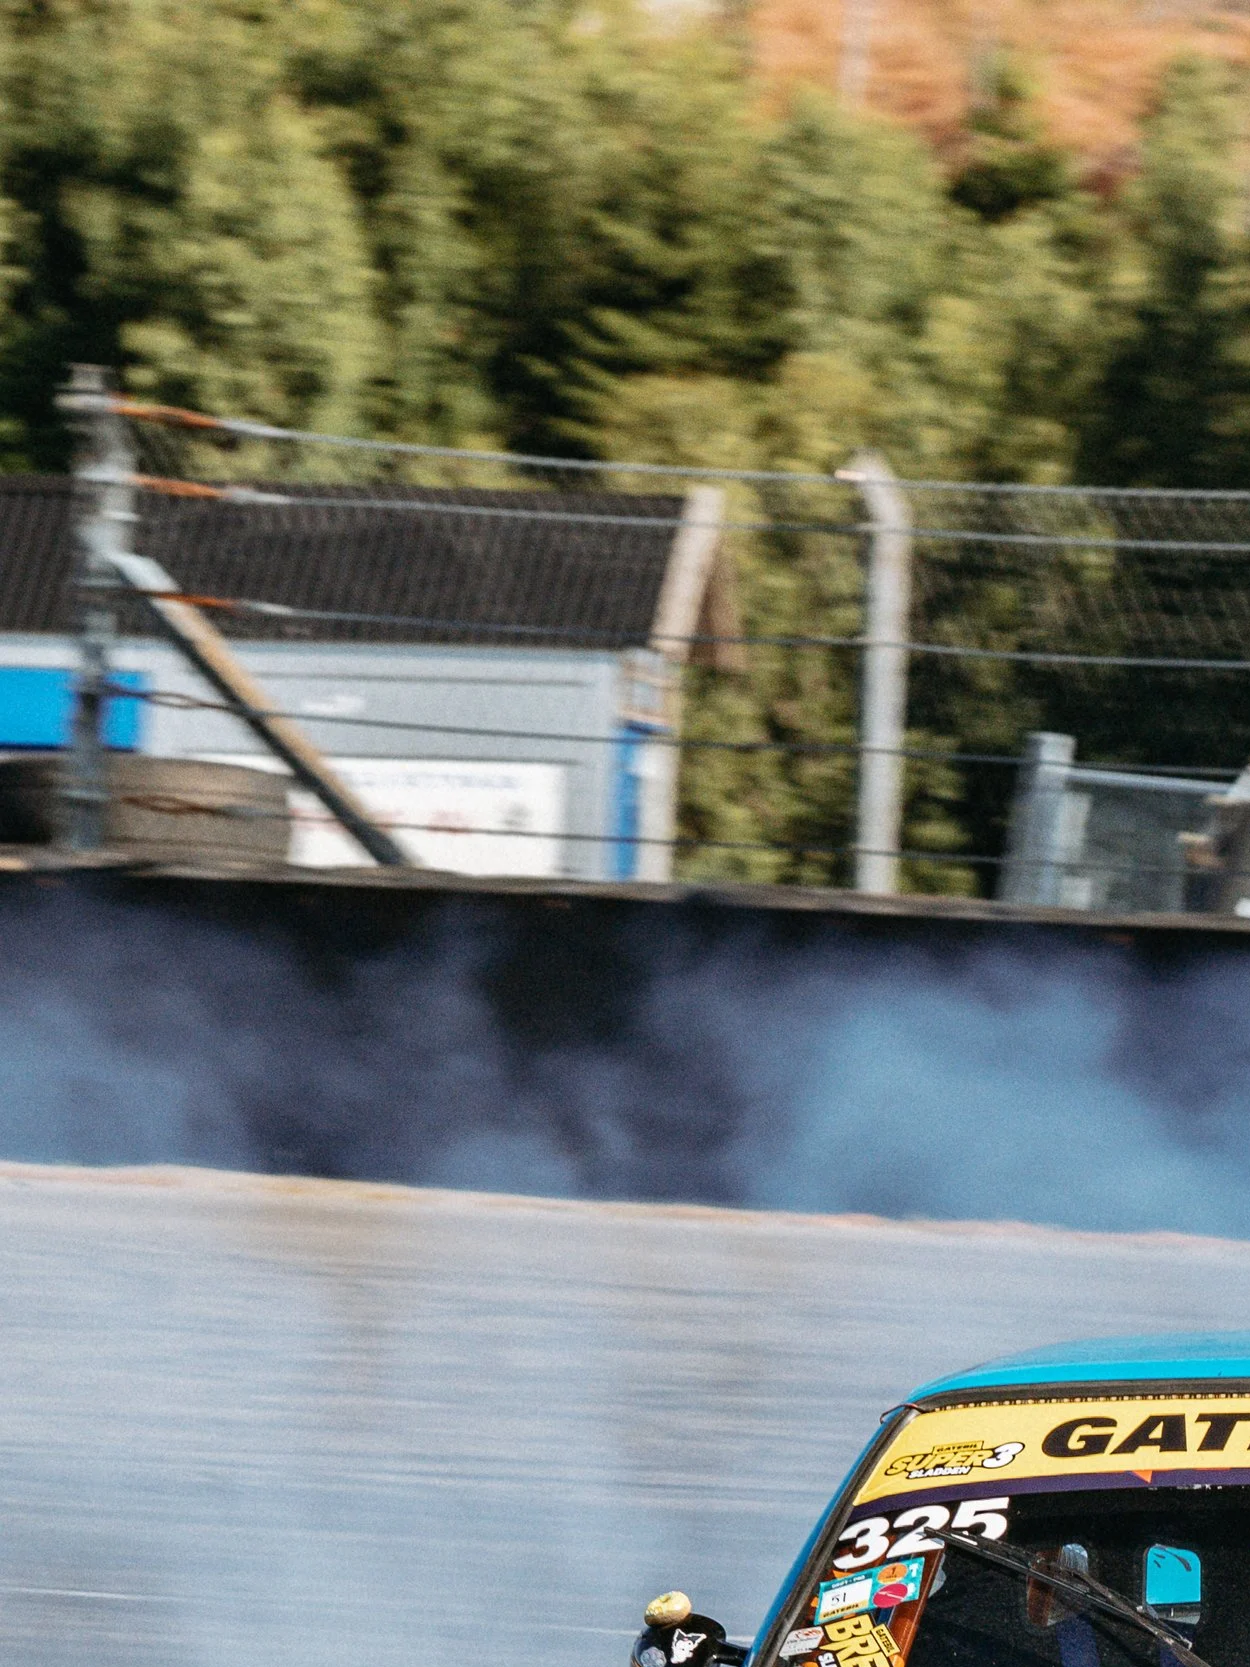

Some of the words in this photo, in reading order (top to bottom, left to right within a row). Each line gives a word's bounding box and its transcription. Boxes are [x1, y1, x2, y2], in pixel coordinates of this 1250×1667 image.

[885, 1450, 993, 1475] SUPER
[982, 1442, 1025, 1469] 3
[907, 1466, 972, 1480] SLADDEN
[832, 1497, 1010, 1570] 325
